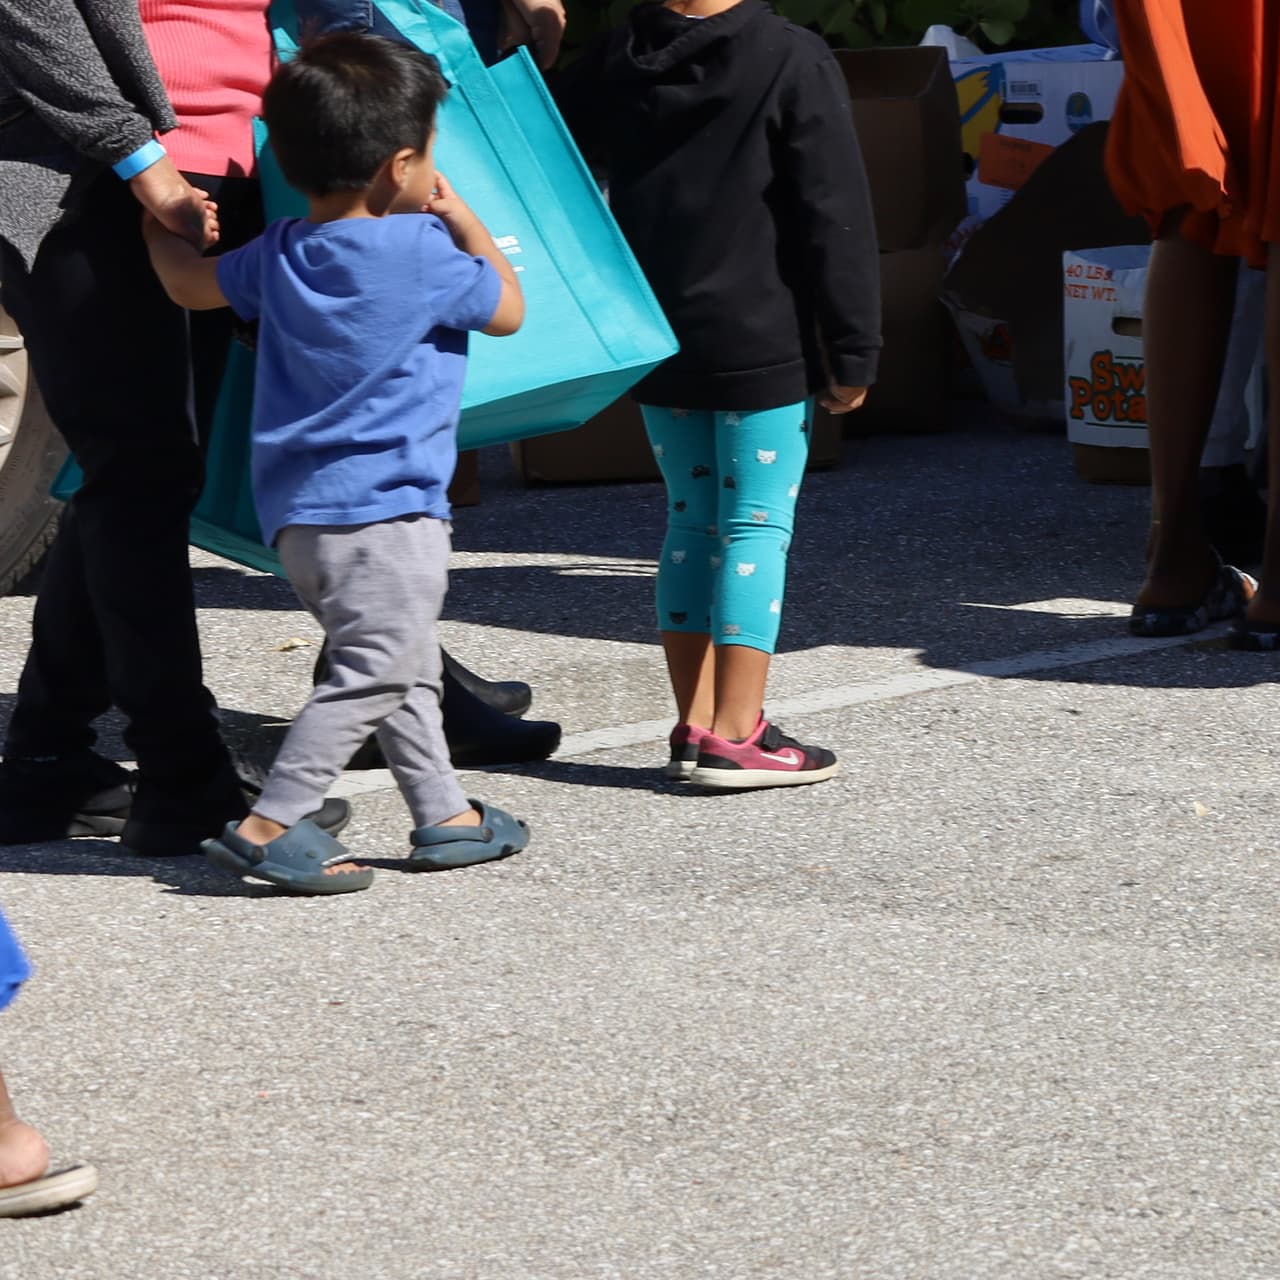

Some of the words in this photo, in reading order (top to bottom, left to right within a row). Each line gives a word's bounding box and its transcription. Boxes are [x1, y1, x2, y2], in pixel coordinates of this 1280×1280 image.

[1066, 263, 1082, 277] 40
[1089, 349, 1147, 394] Sw
[1068, 376, 1149, 423] Pota
